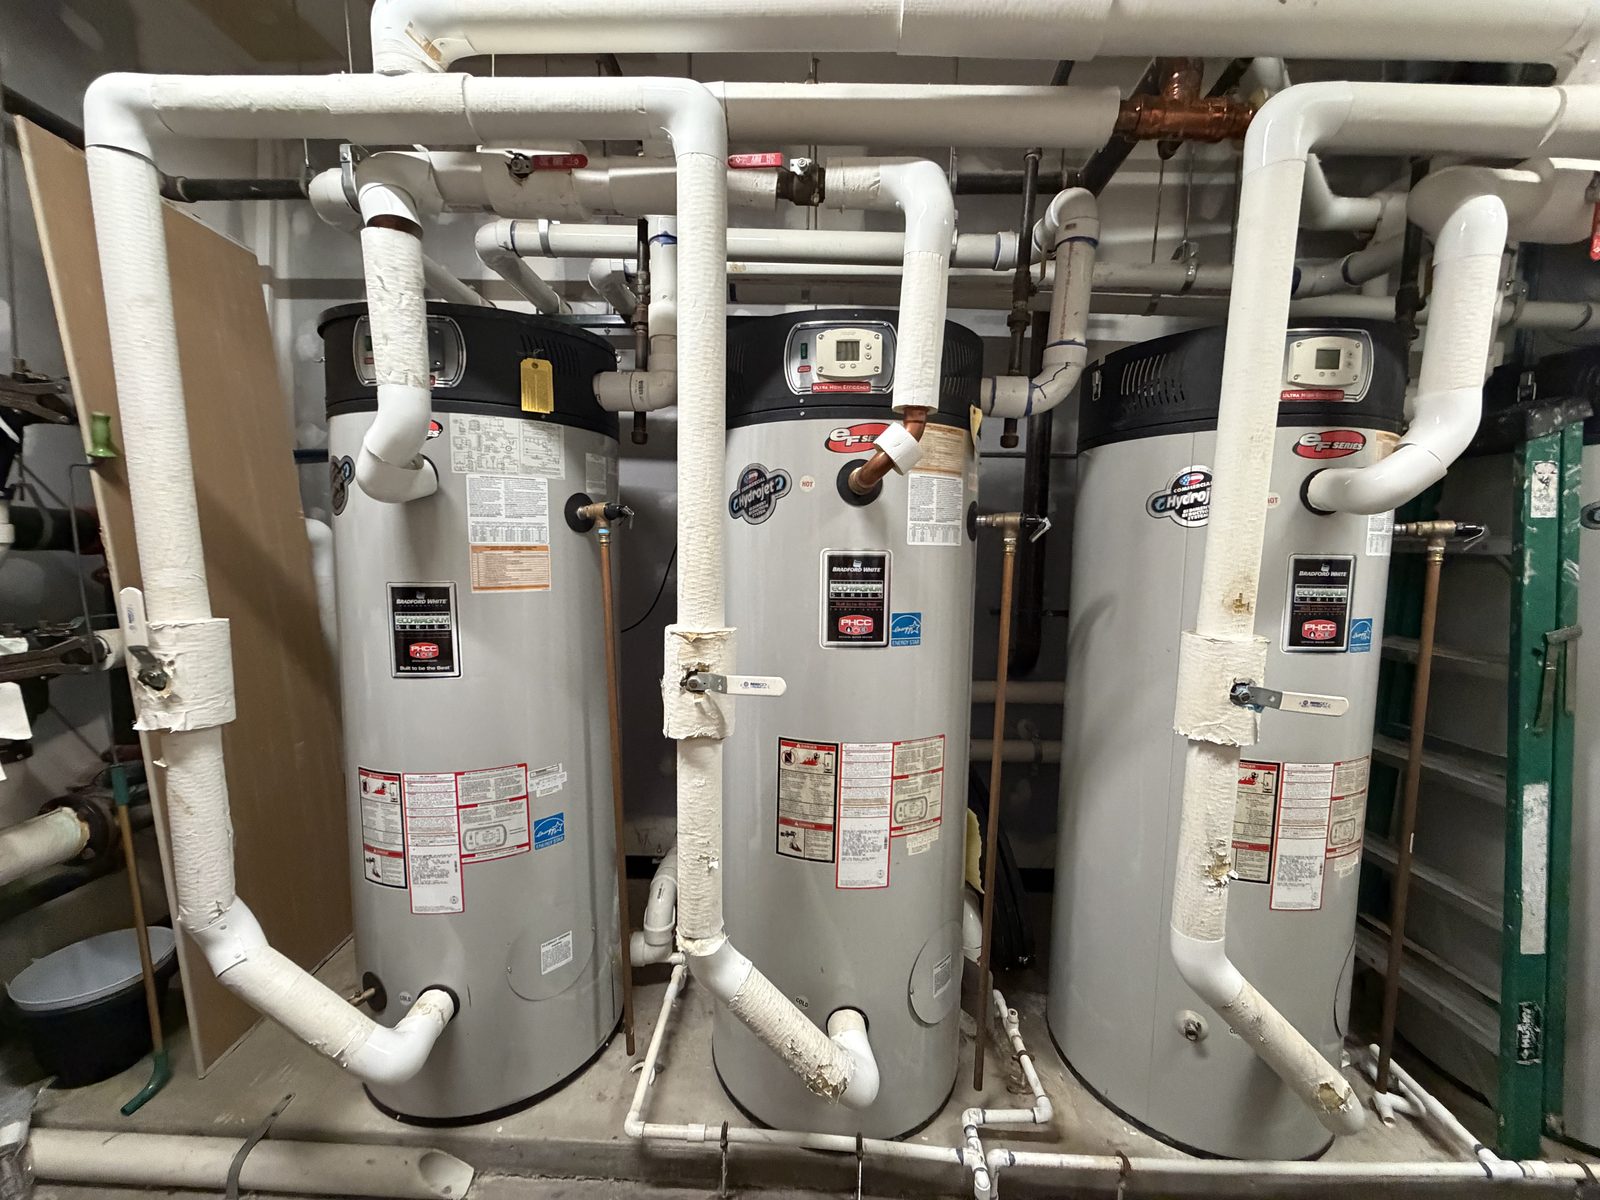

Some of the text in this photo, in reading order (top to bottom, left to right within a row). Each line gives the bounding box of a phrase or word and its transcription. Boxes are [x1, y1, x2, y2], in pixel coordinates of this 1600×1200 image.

[1332, 441, 1363, 450] SERIES
[738, 480, 775, 508] Hydrojet
[1166, 487, 1210, 509] Hydroj
[1304, 623, 1336, 631] PHCC
[795, 997, 809, 1008] COLD
